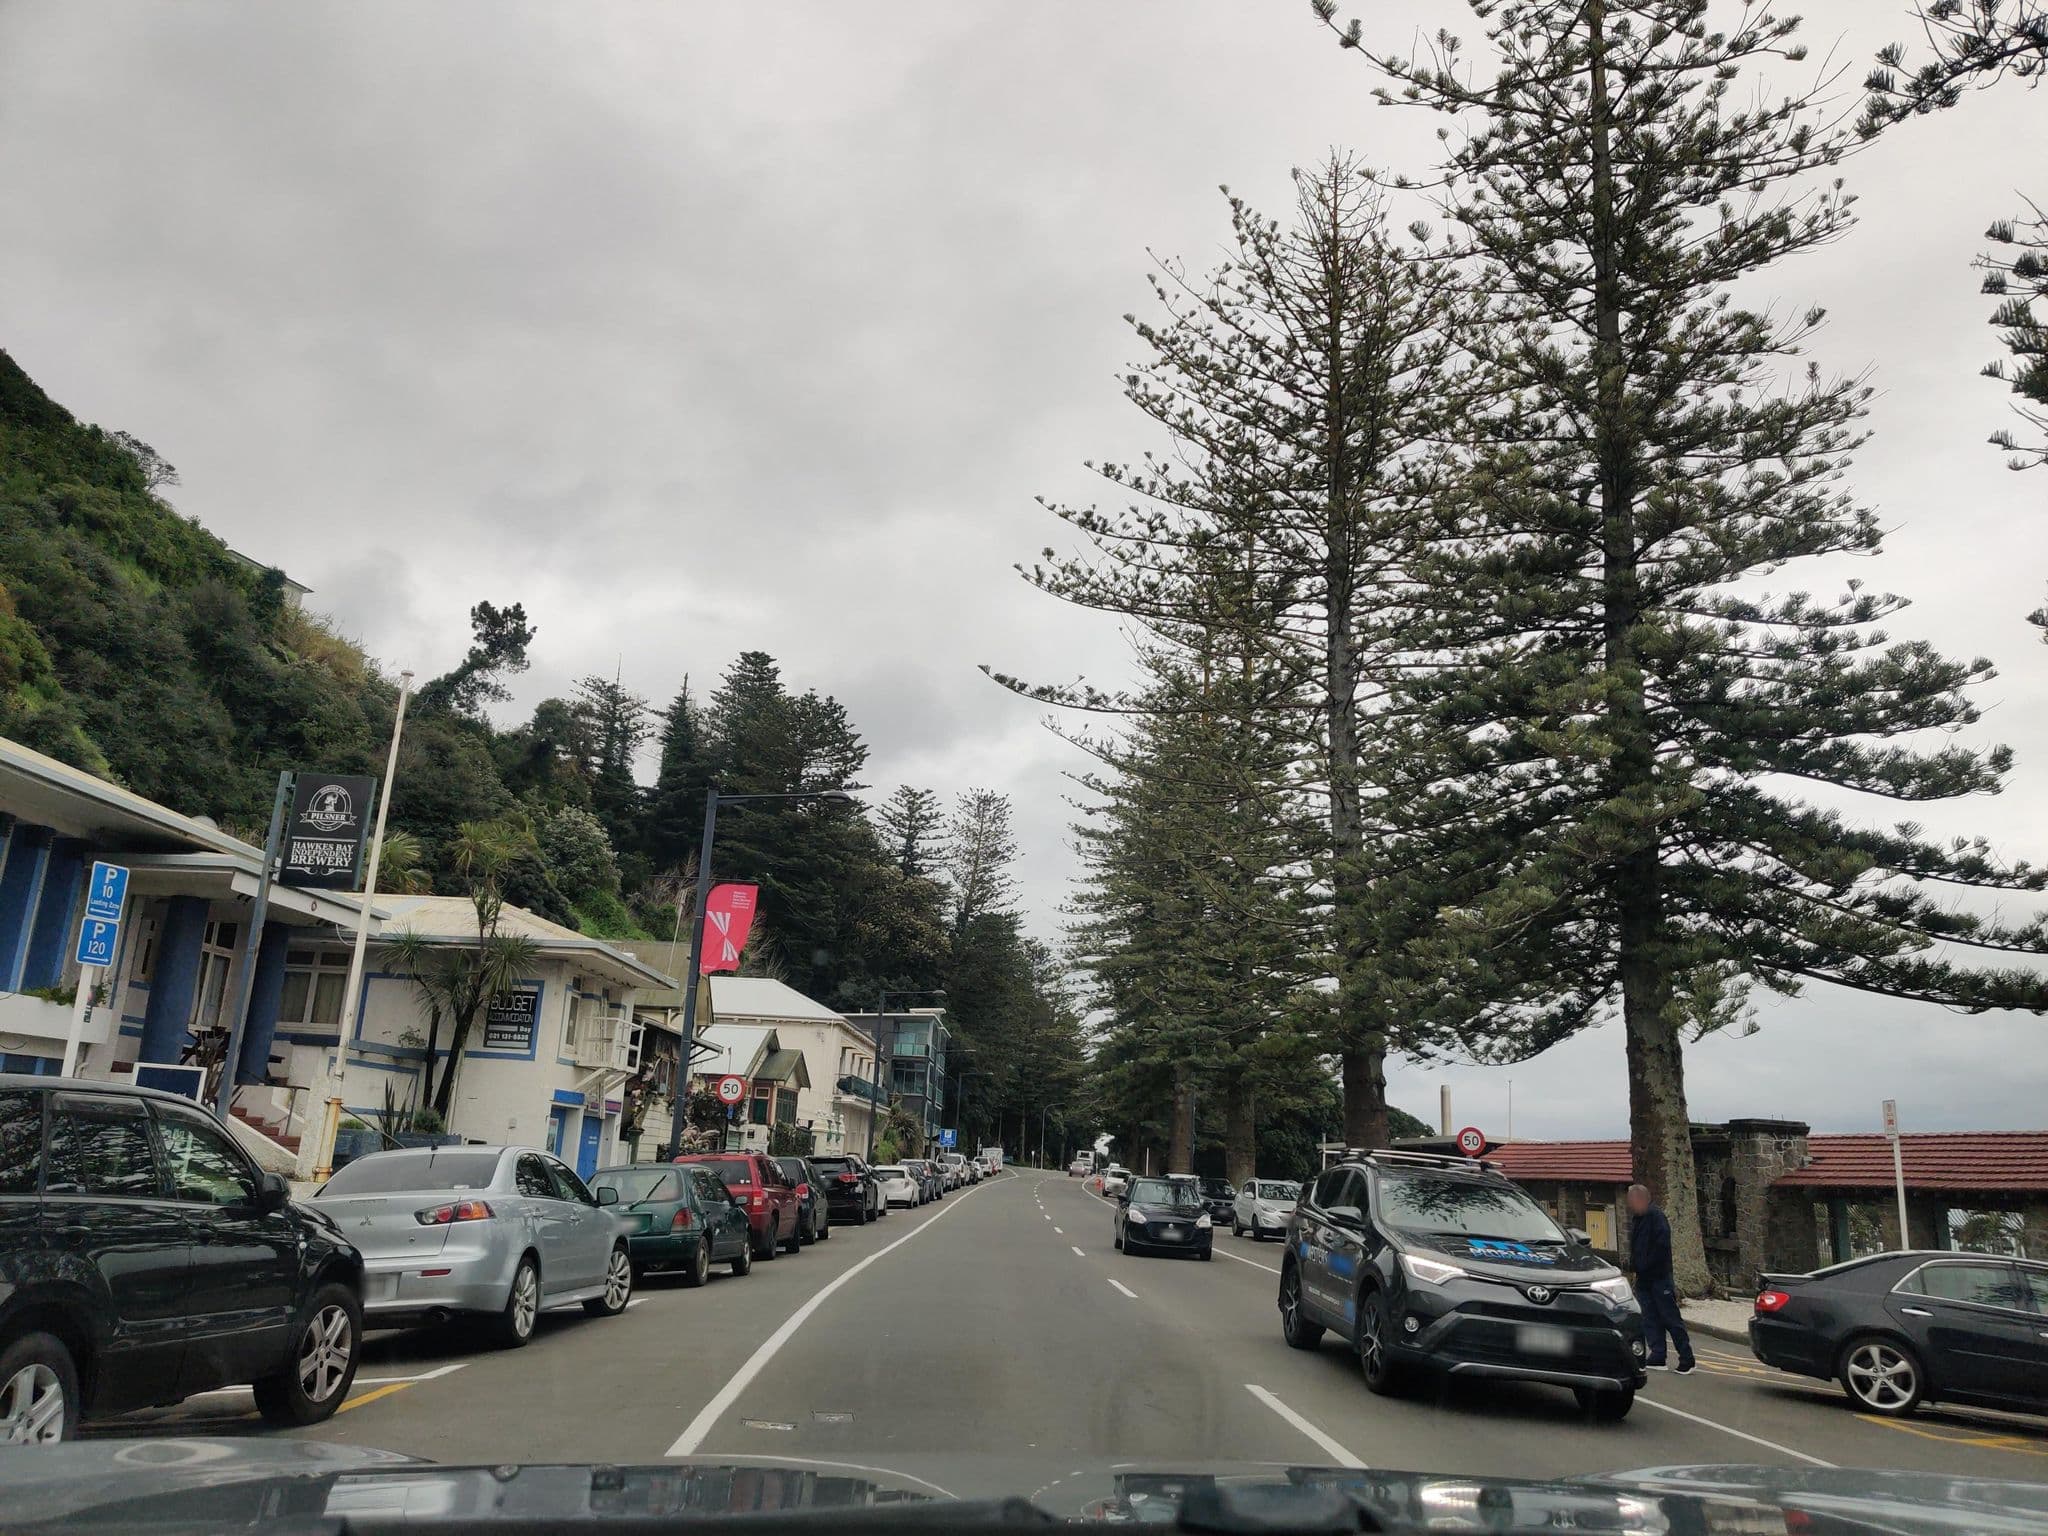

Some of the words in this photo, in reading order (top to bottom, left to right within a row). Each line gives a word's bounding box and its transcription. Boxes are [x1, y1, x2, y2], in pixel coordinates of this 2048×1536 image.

[310, 812, 346, 821] PILSNER
[291, 848, 354, 858] INDEPENDENT
[293, 842, 334, 850] HAWKES
[336, 844, 354, 852] BAY
[289, 854, 353, 867] BREWERY
[106, 868, 118, 884] P
[103, 886, 113, 898] 10
[90, 898, 108, 909] Loading
[94, 923, 106, 939] P
[87, 940, 106, 955] 120
[490, 994, 536, 1012] BUDGET
[723, 1083, 739, 1095] 50
[1464, 1135, 1479, 1146] 50
